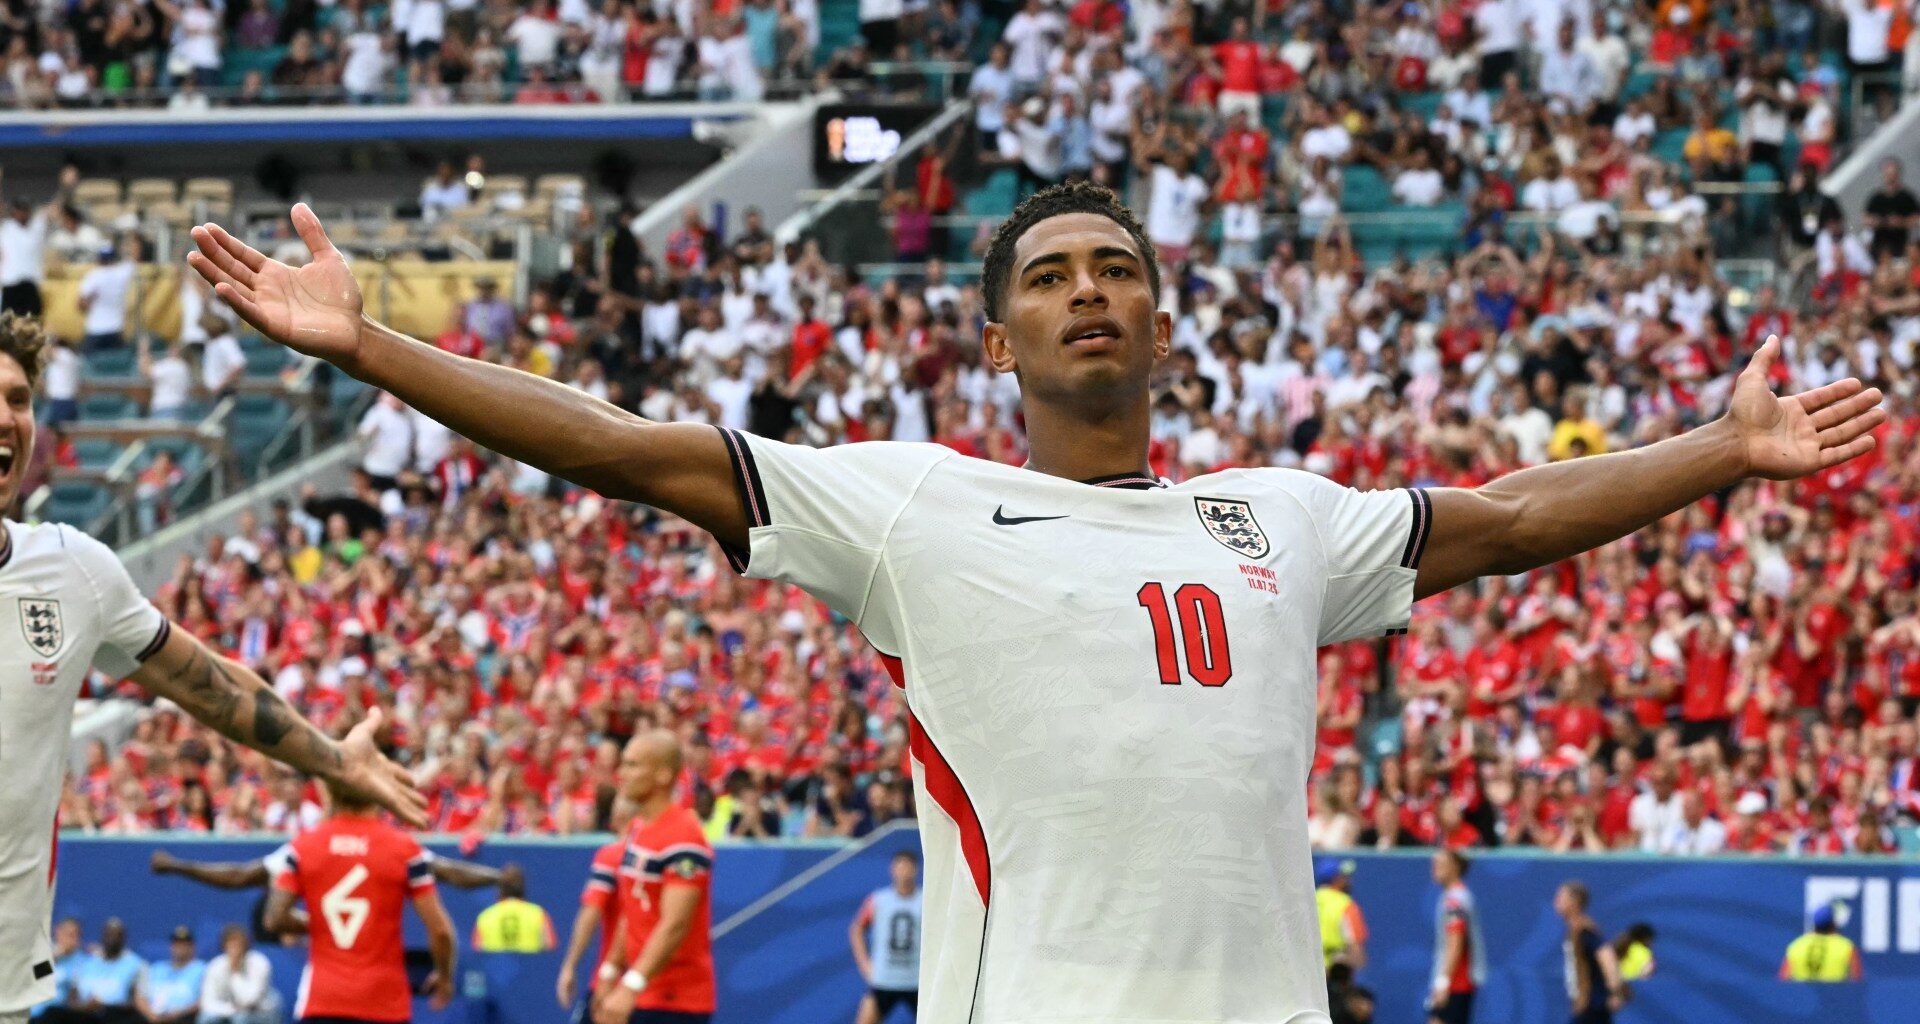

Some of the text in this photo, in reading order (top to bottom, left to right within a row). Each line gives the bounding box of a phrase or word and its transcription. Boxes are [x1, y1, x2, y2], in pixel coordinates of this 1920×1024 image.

[1239, 564, 1277, 580] NORWAY
[1136, 582, 1232, 687] 10
[322, 863, 370, 950] 6
